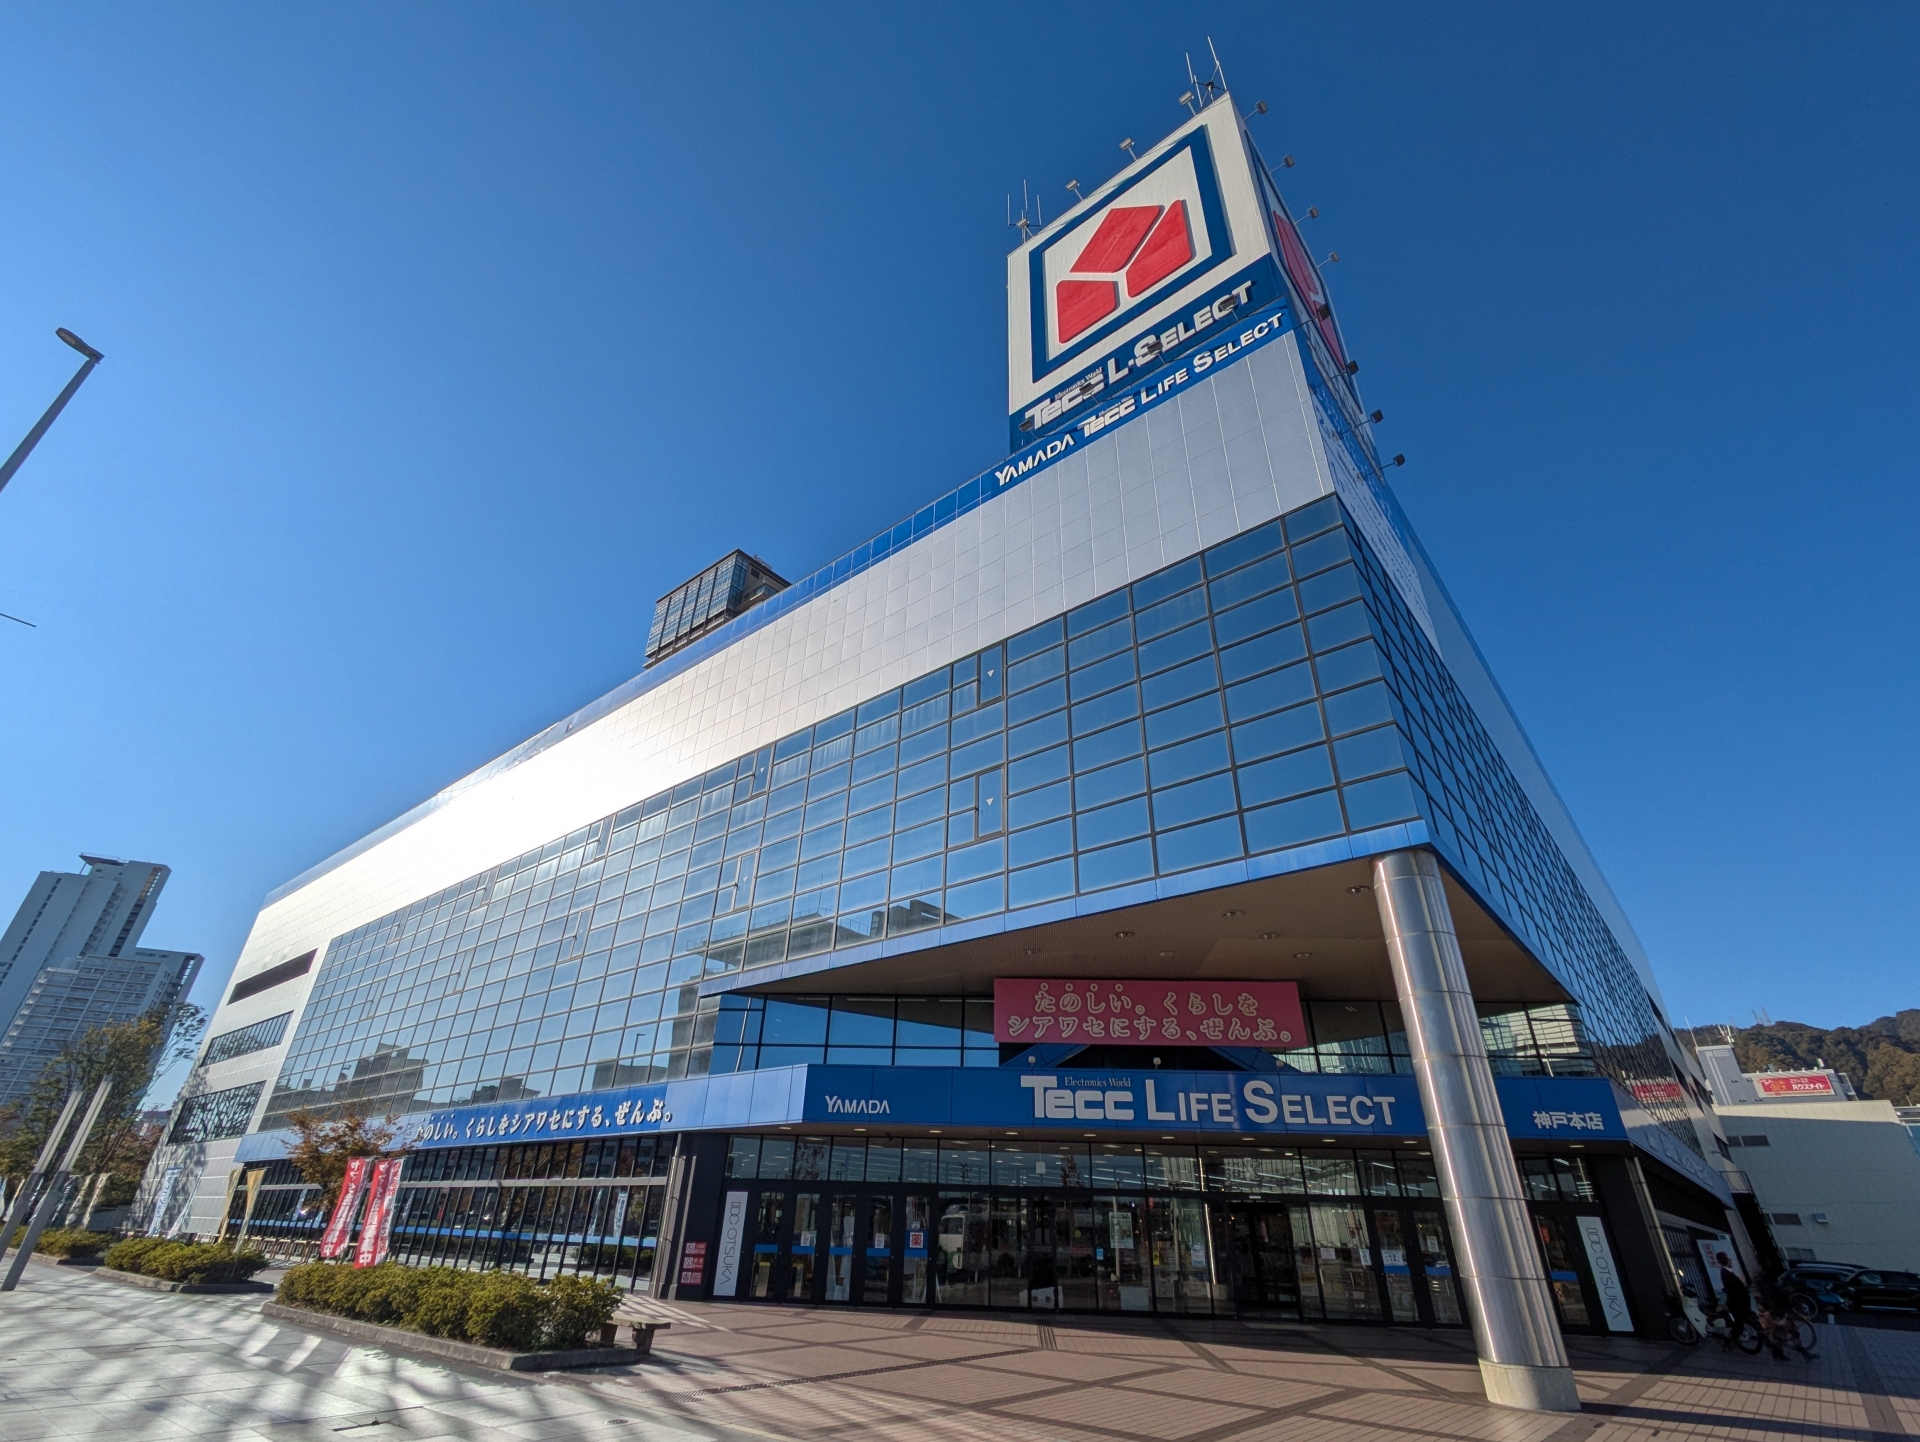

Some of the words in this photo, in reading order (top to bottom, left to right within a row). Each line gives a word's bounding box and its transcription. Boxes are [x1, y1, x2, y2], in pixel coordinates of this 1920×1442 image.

[995, 434, 1075, 486] YAMADA
[1141, 367, 1189, 404] LIFE
[1193, 312, 1282, 374] SELECT
[824, 1095, 890, 1114] YAMADA
[1145, 1079, 1235, 1123] LIFE
[1243, 1080, 1396, 1126] SELECT
[1064, 1077, 1107, 1087] Electronics
[1108, 1078, 1131, 1088] World
[1532, 1110, 1604, 1131] 神戸本店
[729, 1201, 741, 1225] IDC
[720, 1227, 738, 1286] OTSUKA
[1586, 1227, 1604, 1254] IDC
[1596, 1256, 1623, 1320] OTSUKA
